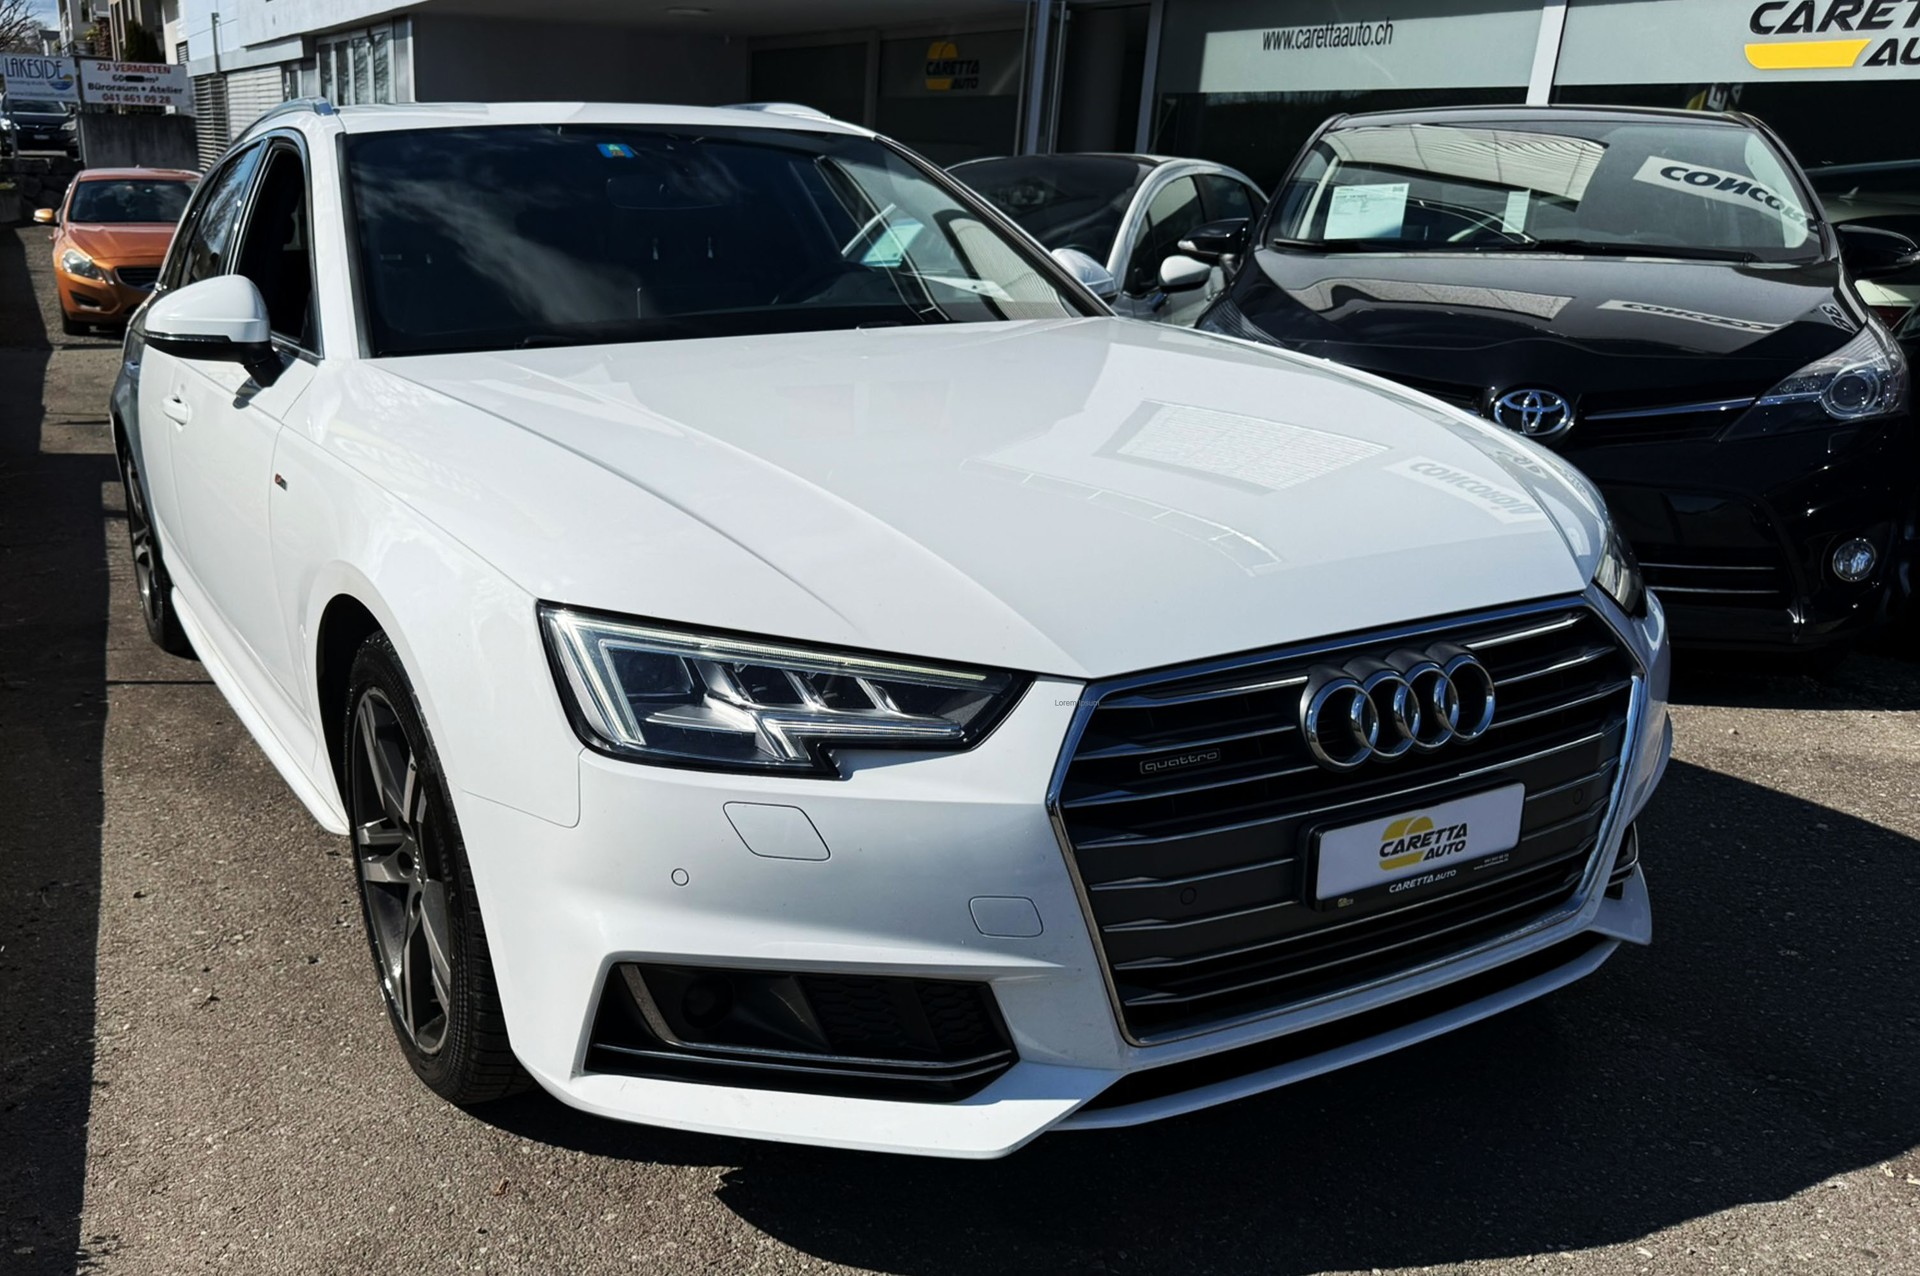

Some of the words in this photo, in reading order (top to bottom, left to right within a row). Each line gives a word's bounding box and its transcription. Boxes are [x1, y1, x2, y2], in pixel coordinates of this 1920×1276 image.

[1263, 17, 1393, 50] www.carettaauto.ch
[5, 57, 63, 80] LAKESIDE
[114, 64, 171, 74] VERMIETEN
[88, 83, 139, 92] Büroraum
[149, 86, 183, 94] Atelier
[1144, 752, 1218, 771] quattro
[1380, 822, 1467, 858] CARETTA
[1423, 840, 1466, 861] AUTO
[1389, 875, 1434, 893] CARETTA
[1435, 869, 1457, 881] AUTO
